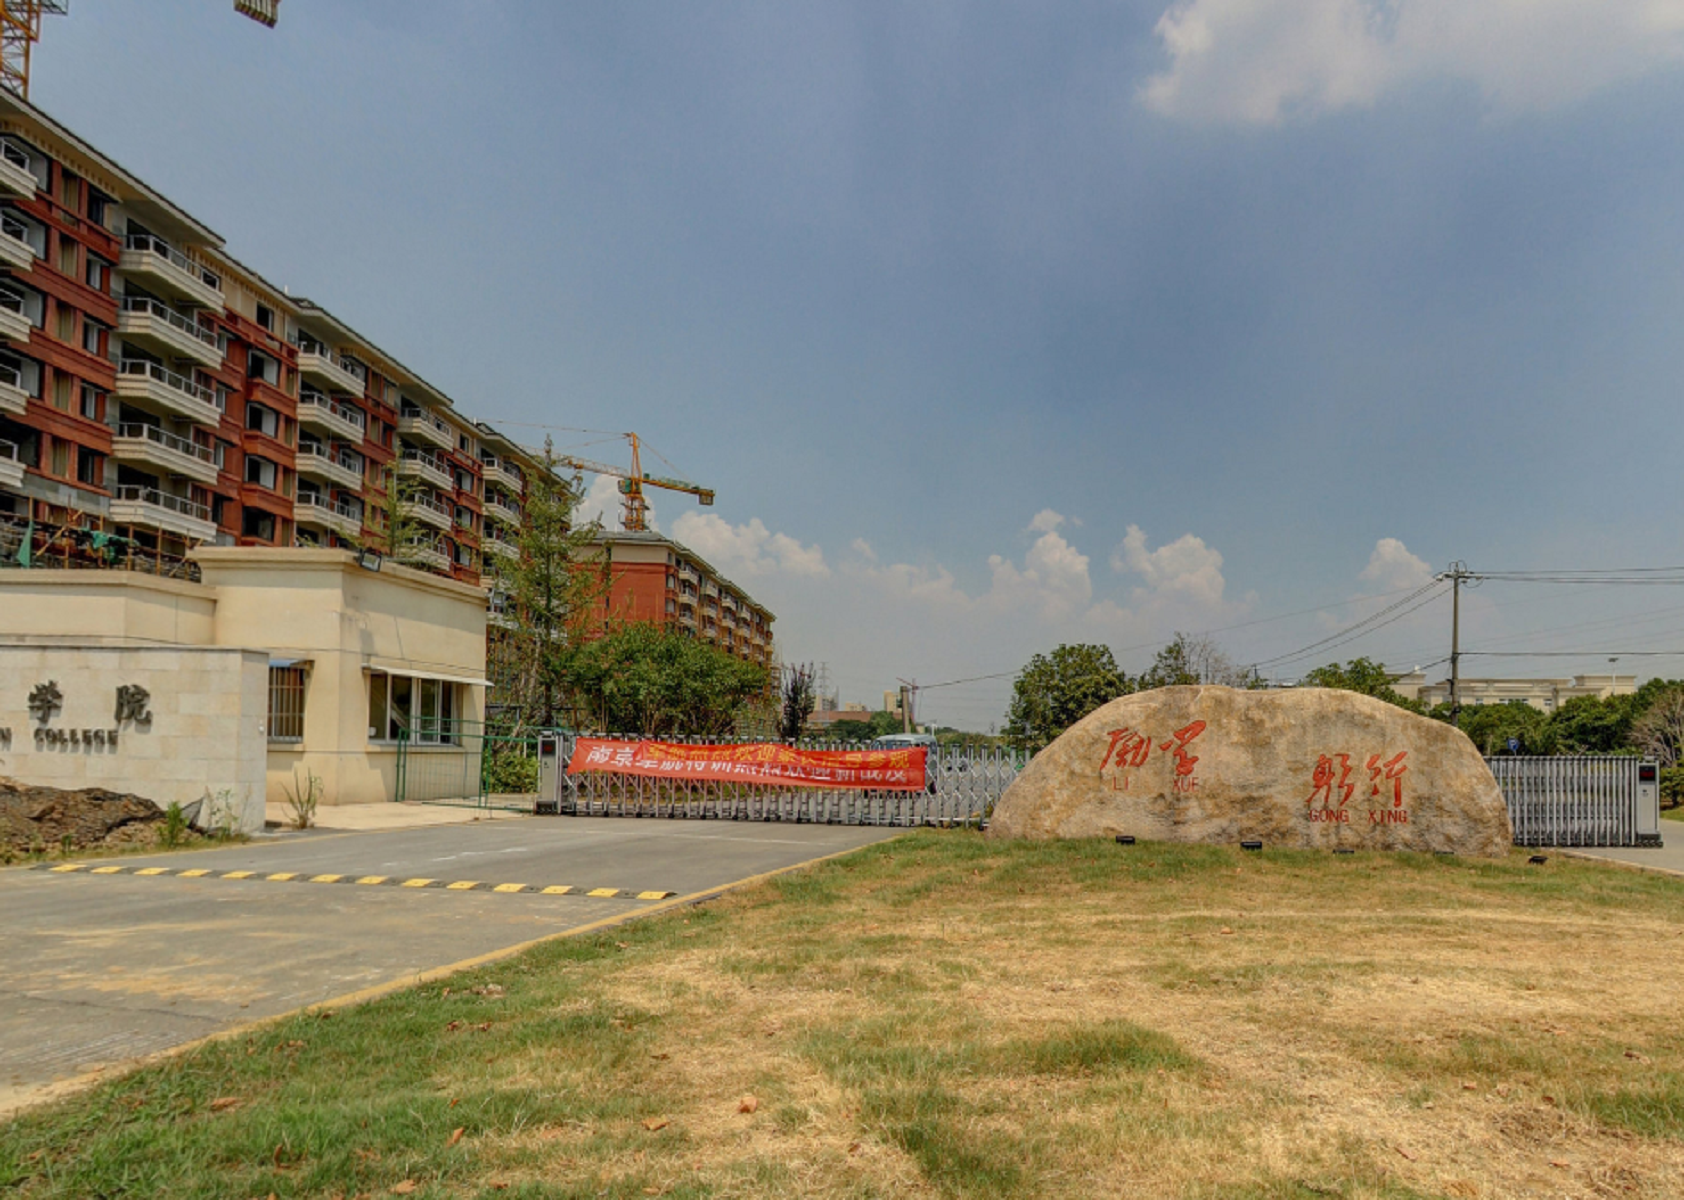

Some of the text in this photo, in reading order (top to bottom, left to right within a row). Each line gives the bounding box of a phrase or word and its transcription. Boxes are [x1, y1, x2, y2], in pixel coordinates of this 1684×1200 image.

[27, 679, 153, 725] 学院
[33, 727, 119, 746] COLLEGE
[1112, 777, 1199, 792] LI XUE
[1309, 809, 1408, 823] GONG XING
